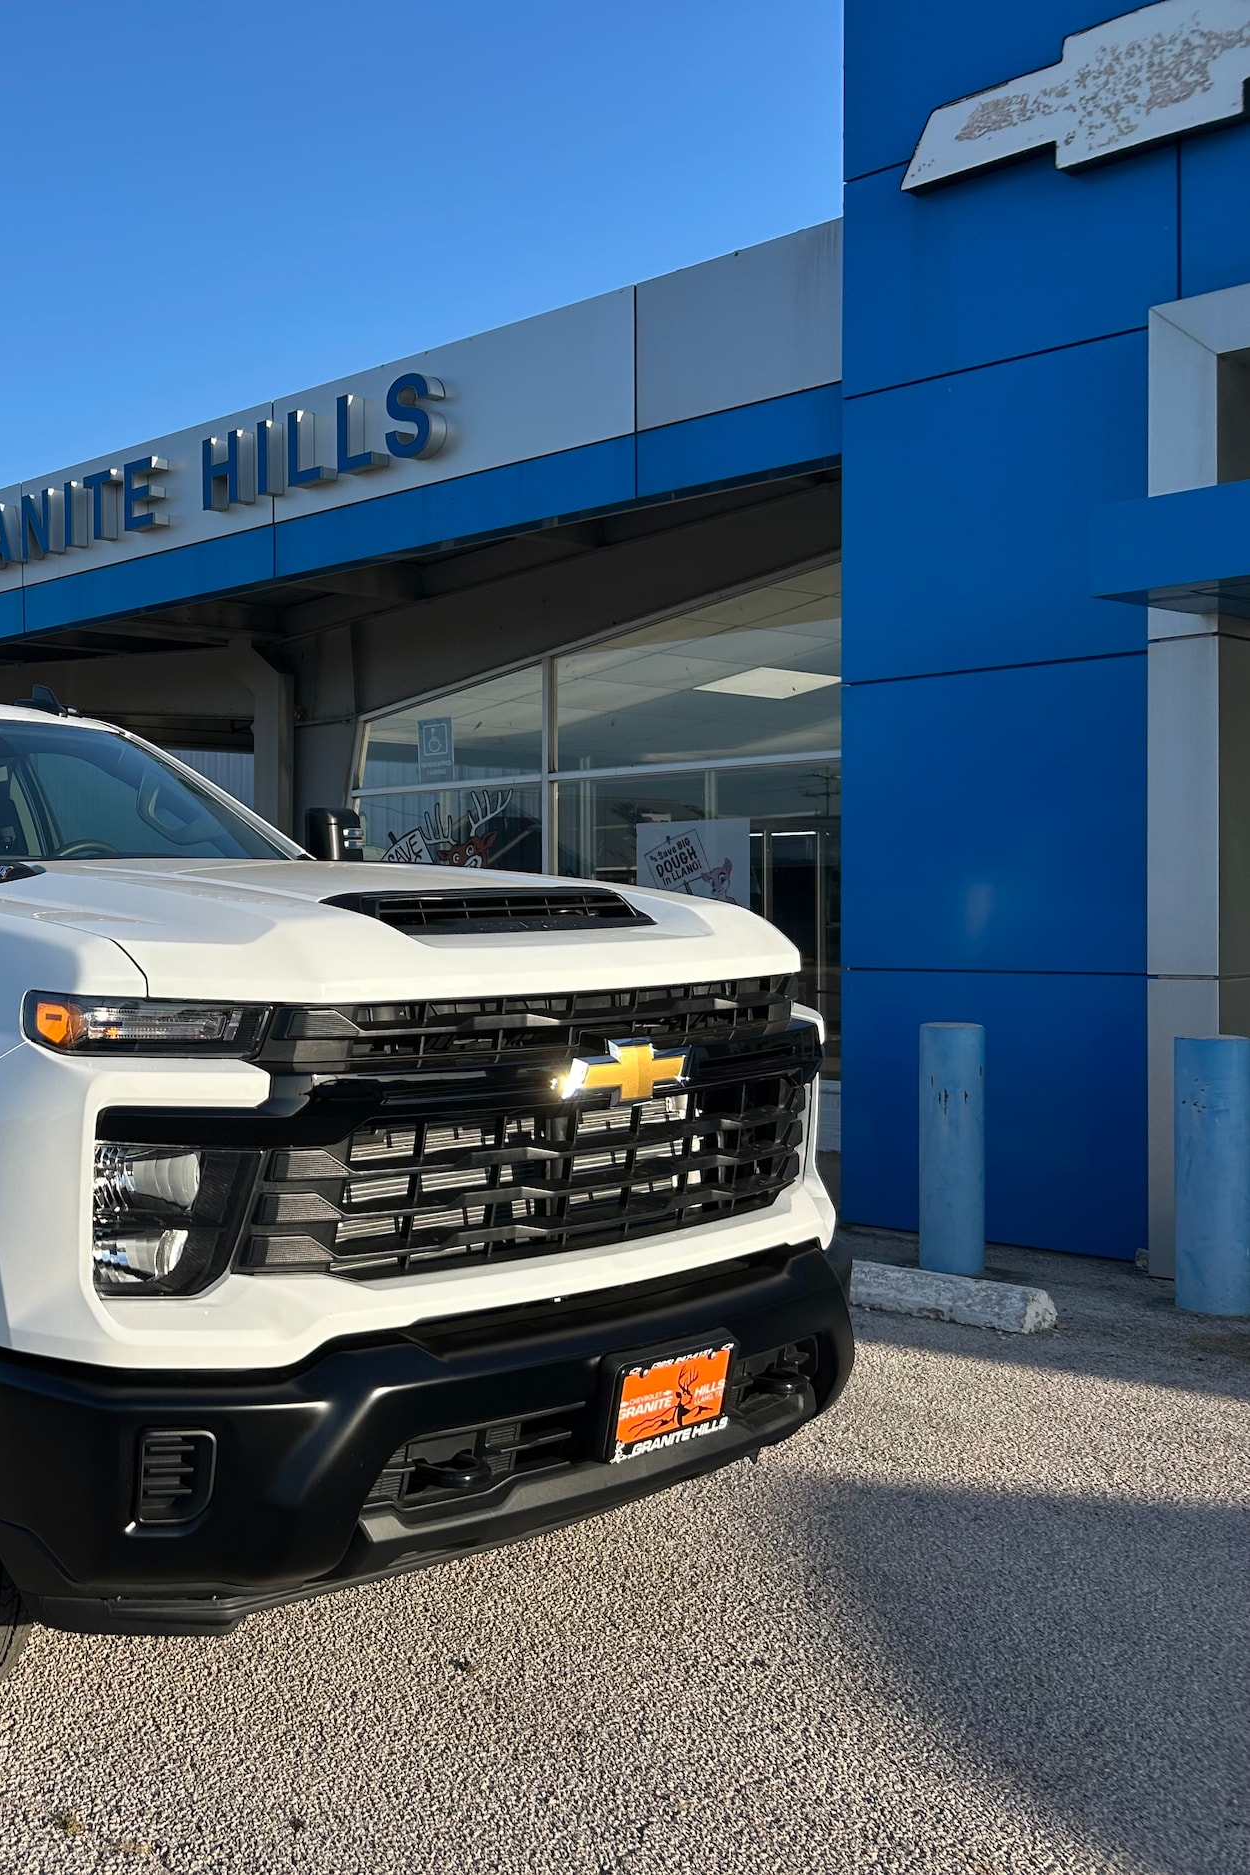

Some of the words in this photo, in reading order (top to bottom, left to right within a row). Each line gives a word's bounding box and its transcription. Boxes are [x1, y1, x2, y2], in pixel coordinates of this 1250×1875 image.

[202, 372, 446, 512] HILLS
[656, 845, 698, 878] DOUGH
[657, 846, 677, 860] Save
[676, 837, 690, 850] BIG
[693, 1379, 726, 1398] HILLS
[619, 1396, 673, 1420] GRANITE
[631, 1427, 691, 1458] GRANITE
[691, 1416, 729, 1440] HILLS
